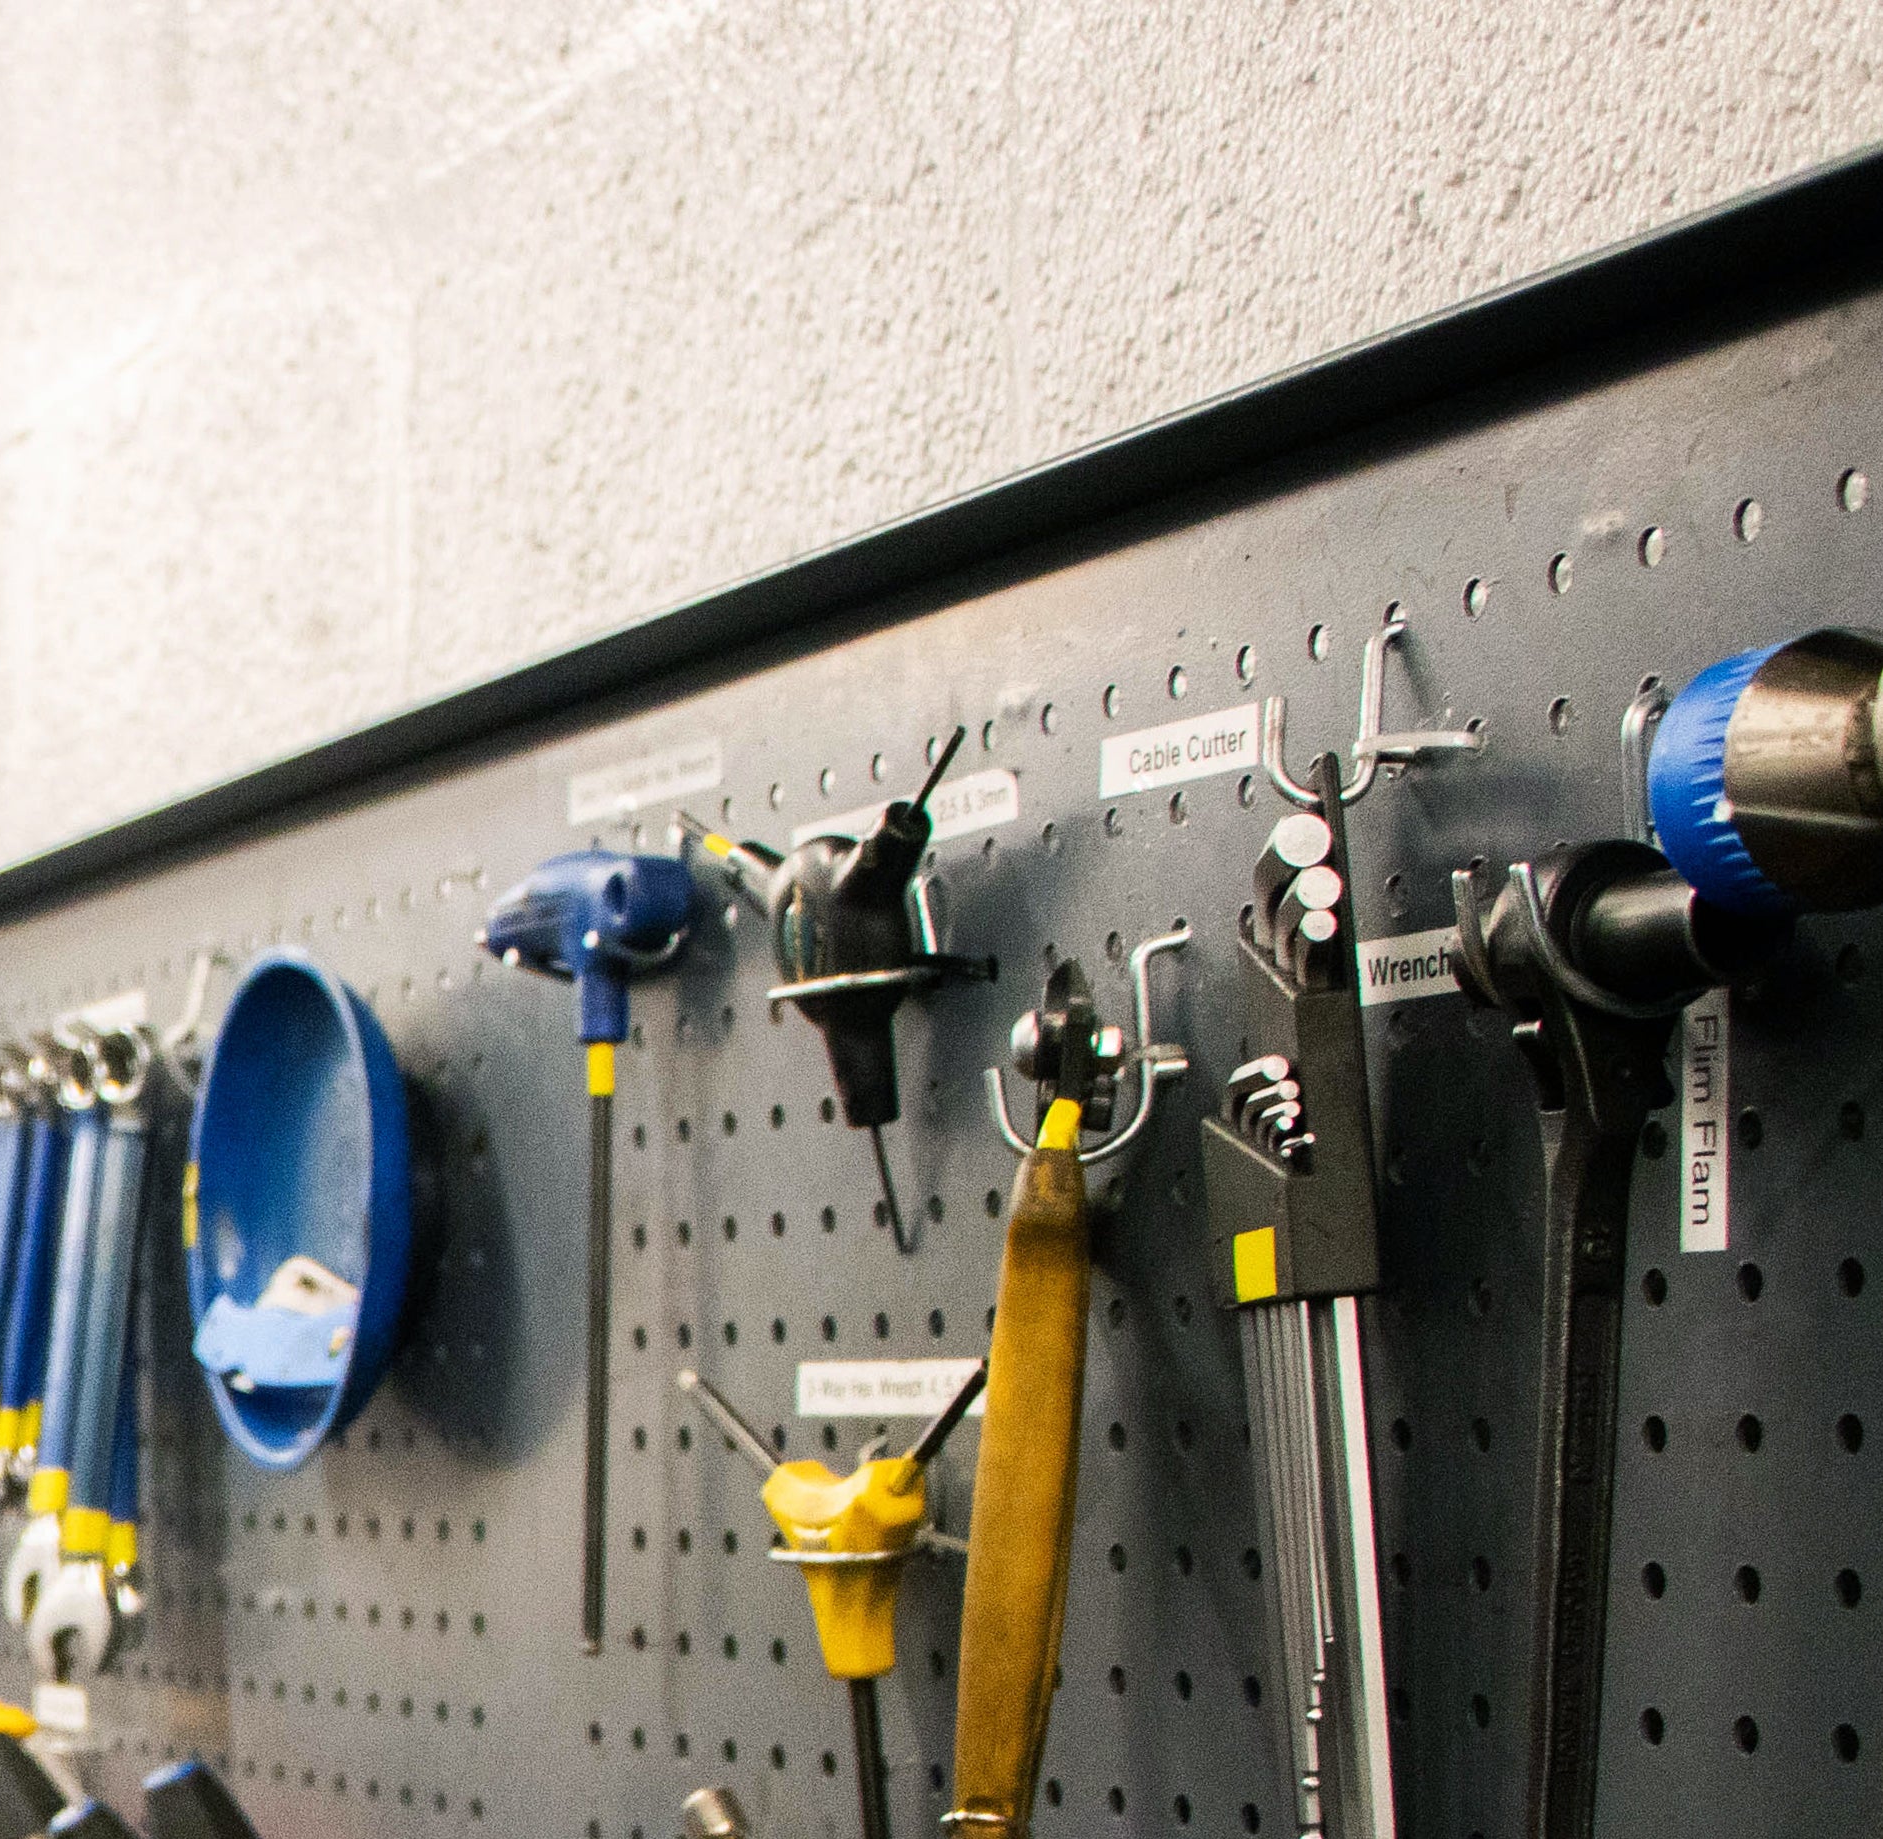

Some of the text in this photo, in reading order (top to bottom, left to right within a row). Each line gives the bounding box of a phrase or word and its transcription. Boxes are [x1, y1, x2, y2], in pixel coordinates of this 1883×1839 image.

[1129, 729, 1247, 774] Cable Cutter
[1367, 946, 1452, 987] Wrench
[1691, 1014, 1719, 1226] Flim Flam
